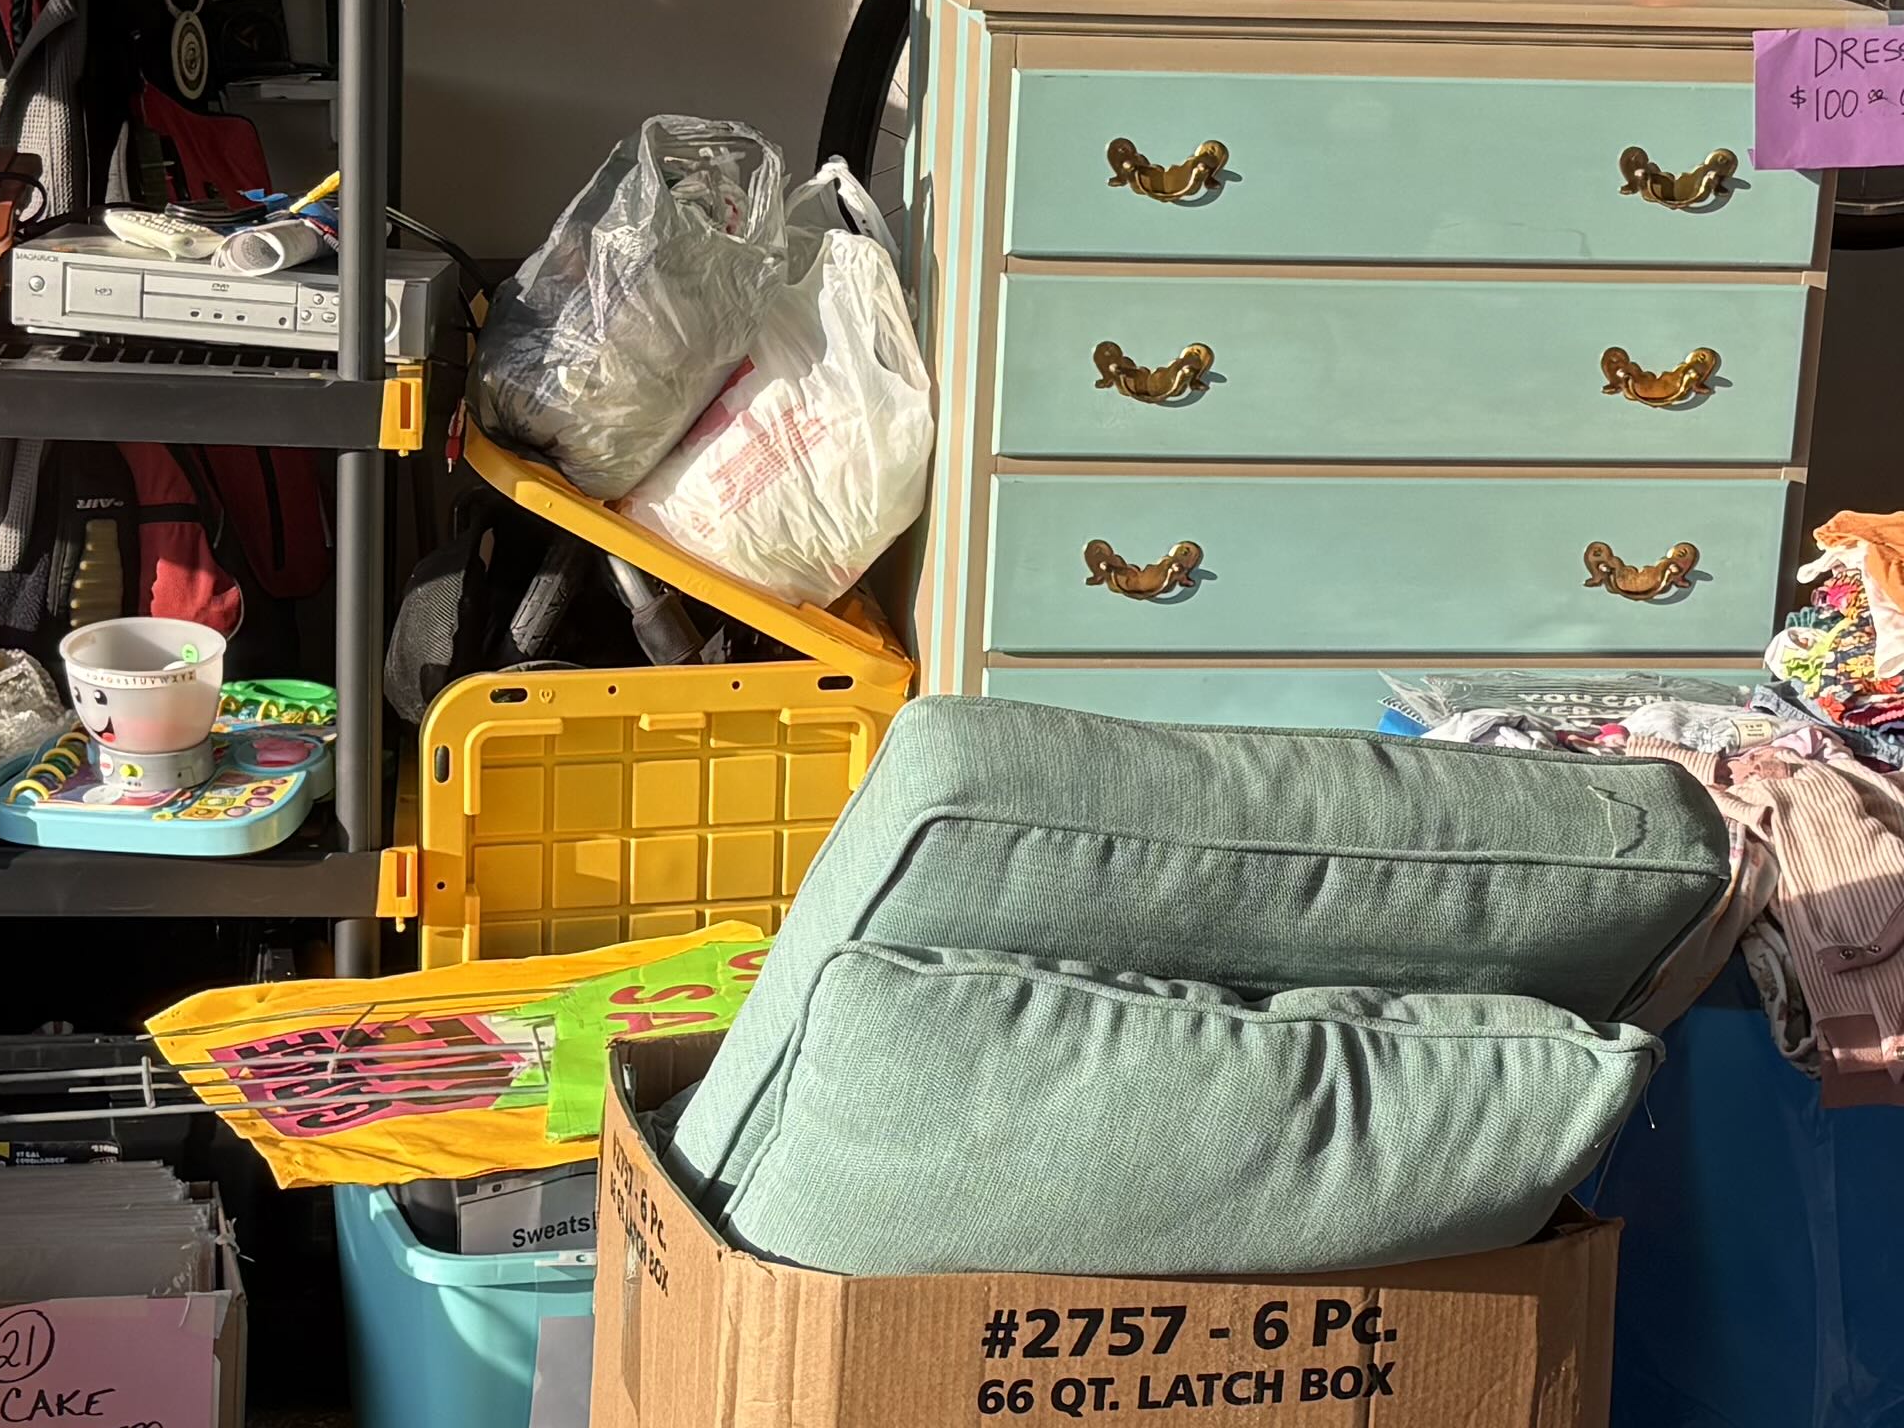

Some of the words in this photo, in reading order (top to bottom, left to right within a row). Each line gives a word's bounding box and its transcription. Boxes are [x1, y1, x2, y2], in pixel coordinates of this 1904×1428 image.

[981, 1305, 1188, 1359] #2757
[1253, 1300, 1289, 1350] 6
[0, 1387, 117, 1423] CAKE
[977, 1379, 1034, 1415] 66
[1050, 1376, 1120, 1418] QT.
[1137, 1370, 1284, 1410] LATCH
[1299, 1362, 1395, 1402] BOX
